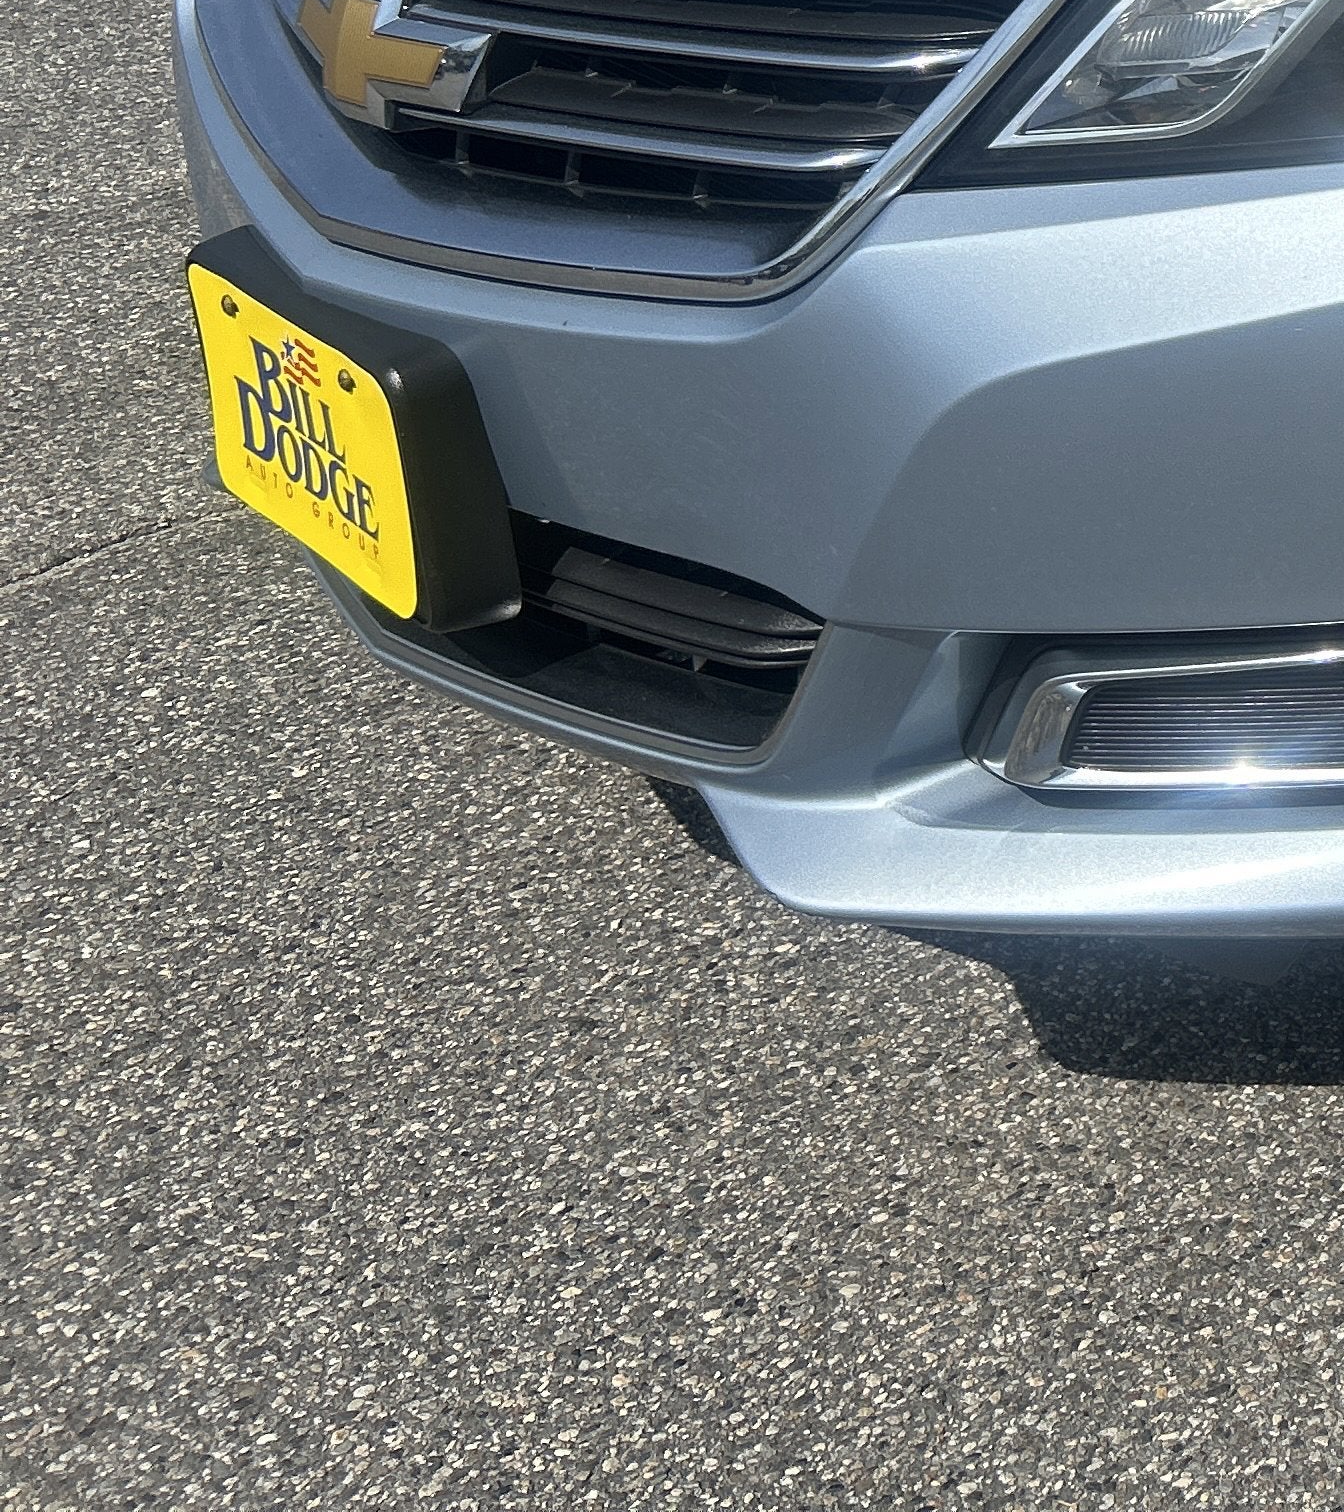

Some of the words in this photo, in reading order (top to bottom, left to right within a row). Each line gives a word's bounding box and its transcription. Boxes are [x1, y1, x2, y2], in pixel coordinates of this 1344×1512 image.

[233, 375, 380, 541] DODGE
[248, 335, 346, 463] BILL
[244, 458, 294, 499] AUTO
[312, 501, 380, 560] GROUP
